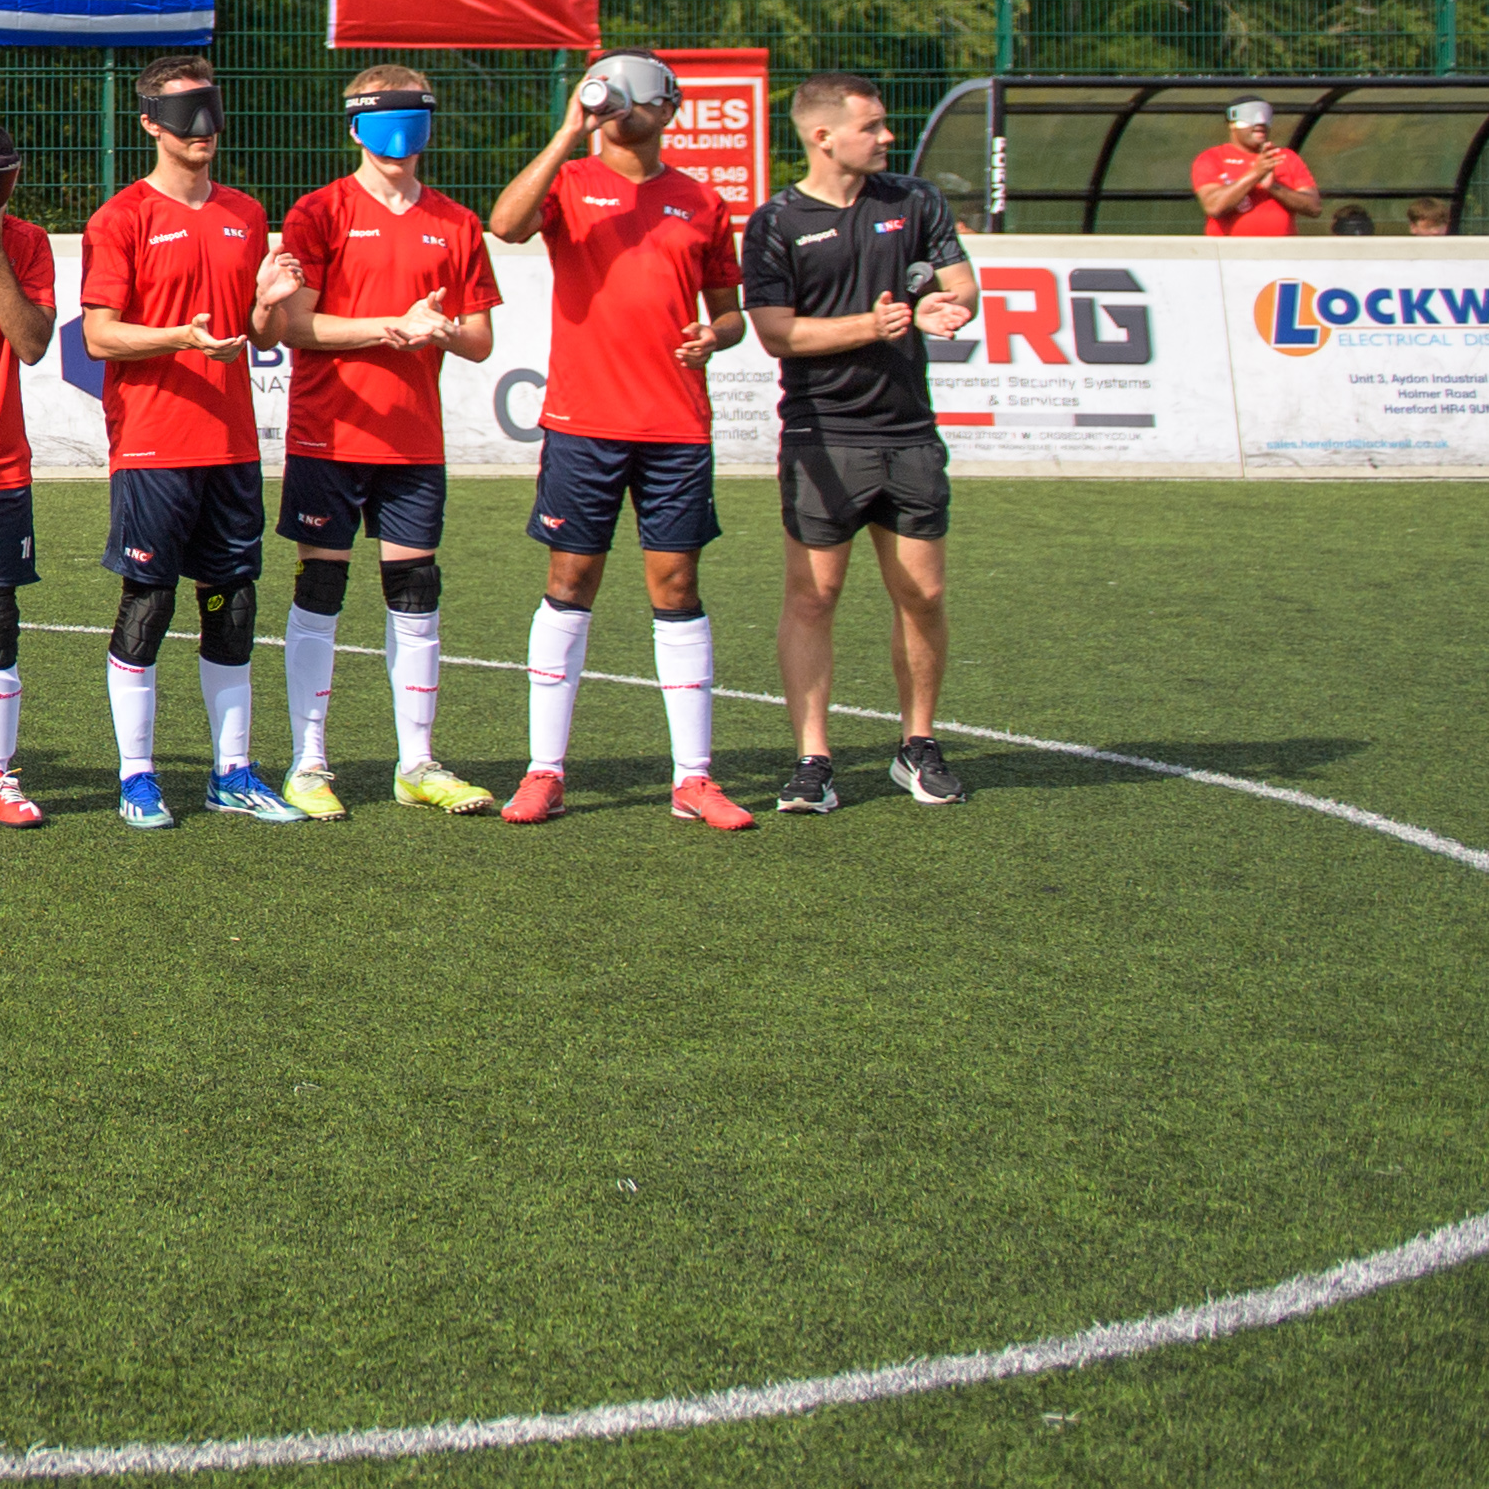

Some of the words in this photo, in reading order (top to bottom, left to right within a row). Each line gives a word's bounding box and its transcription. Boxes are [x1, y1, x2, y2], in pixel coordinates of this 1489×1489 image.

[665, 99, 749, 130] NES
[660, 134, 747, 149] FOLDING
[224, 227, 246, 239] RNC
[875, 219, 905, 234] RNC
[149, 228, 188, 246] uhlsport
[1274, 283, 1489, 345] LOCKW
[1338, 333, 1452, 346] ELECTRICAL
[709, 369, 774, 383] roadcast
[1008, 375, 1075, 390] Security
[1084, 376, 1151, 390] Systems
[1349, 374, 1374, 384] Unit
[1391, 374, 1429, 387] Aydon
[1432, 373, 1489, 384] Industrial
[710, 389, 754, 402] ervice
[988, 395, 999, 406] &
[1008, 395, 1080, 407] Services
[1398, 389, 1442, 399] Holmer
[1444, 389, 1477, 399] Road
[713, 406, 771, 421] olutions
[1384, 404, 1437, 414] Hereford
[1440, 404, 1465, 414] HR4
[714, 426, 758, 440] imited
[124, 546, 149, 562] RNC
